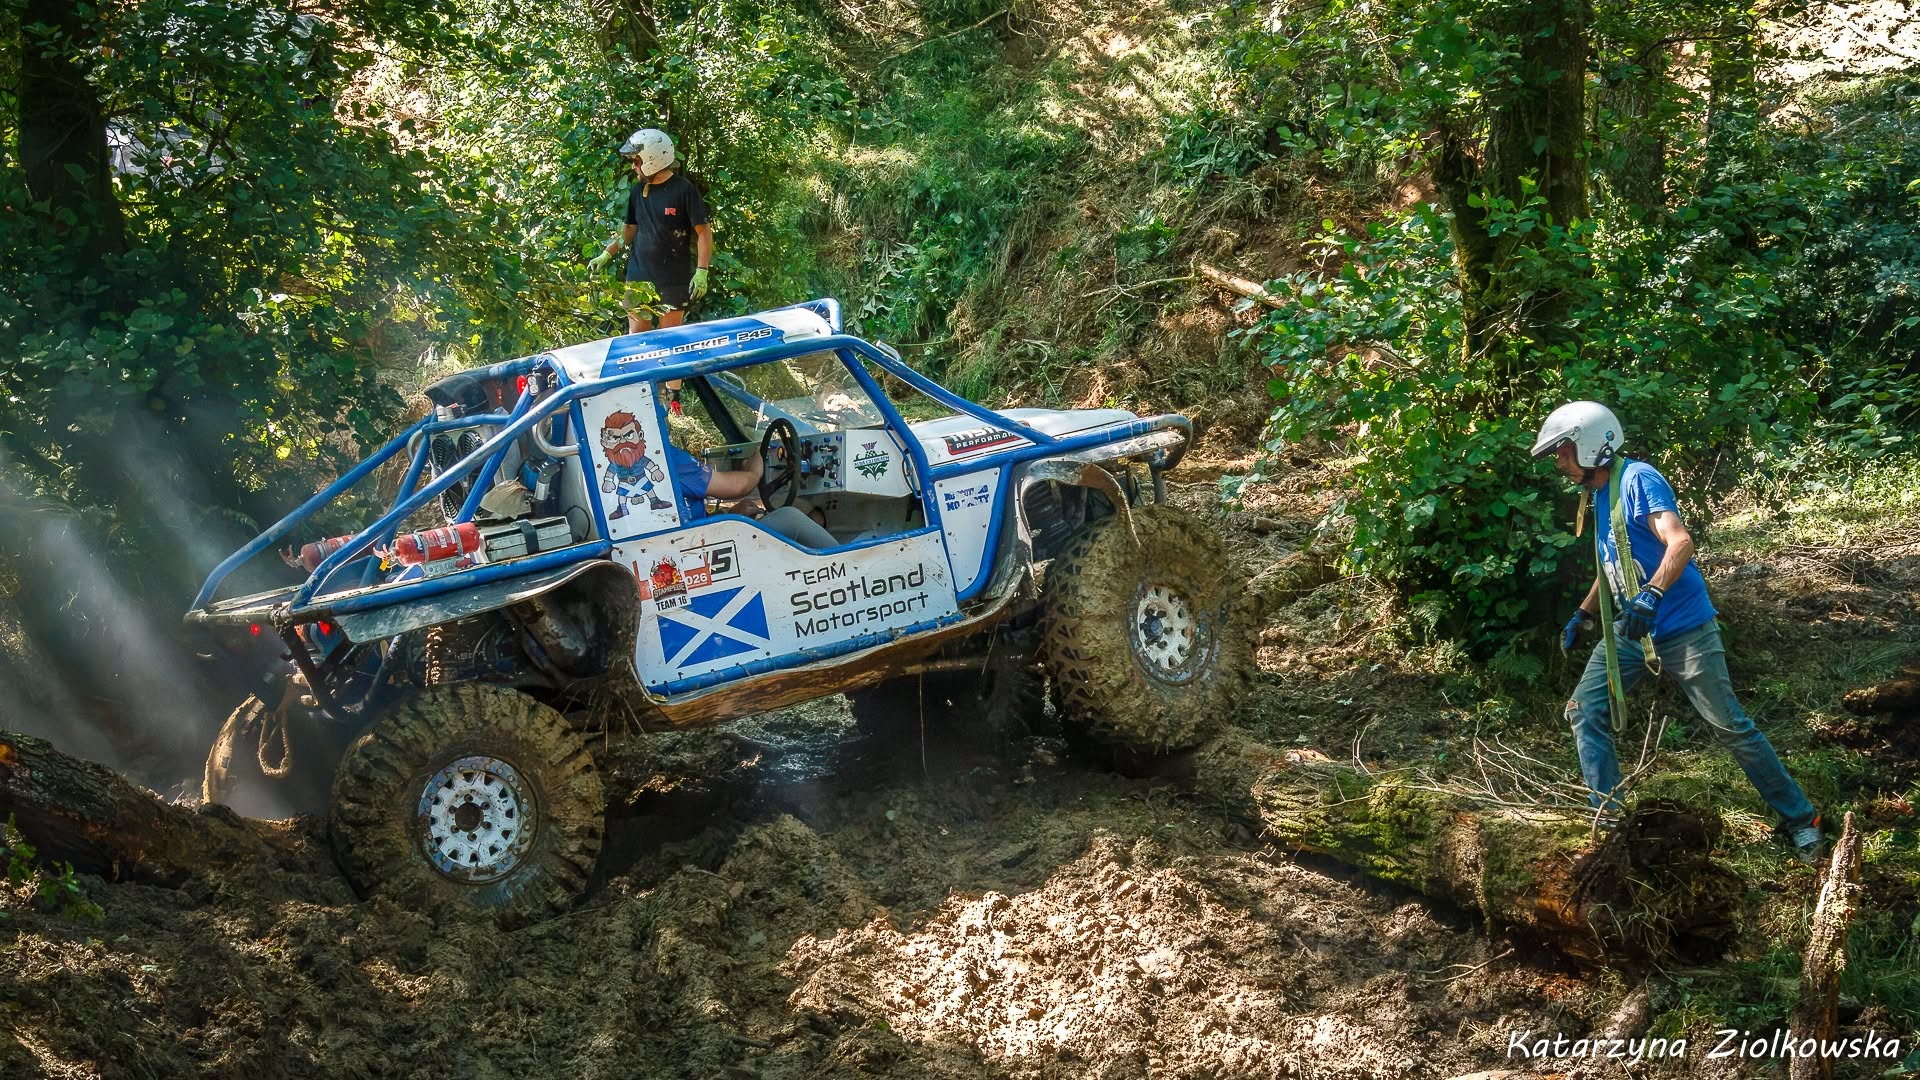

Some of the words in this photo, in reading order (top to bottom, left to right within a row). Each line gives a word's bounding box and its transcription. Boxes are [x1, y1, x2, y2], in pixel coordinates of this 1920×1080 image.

[686, 572, 709, 586] 026
[785, 562, 847, 586] TEAM
[653, 583, 687, 599] STAMPEDE
[790, 562, 926, 616] Scotland
[656, 598, 677, 611] TEAM
[679, 595, 688, 606] 16
[794, 591, 929, 639] Motorsport
